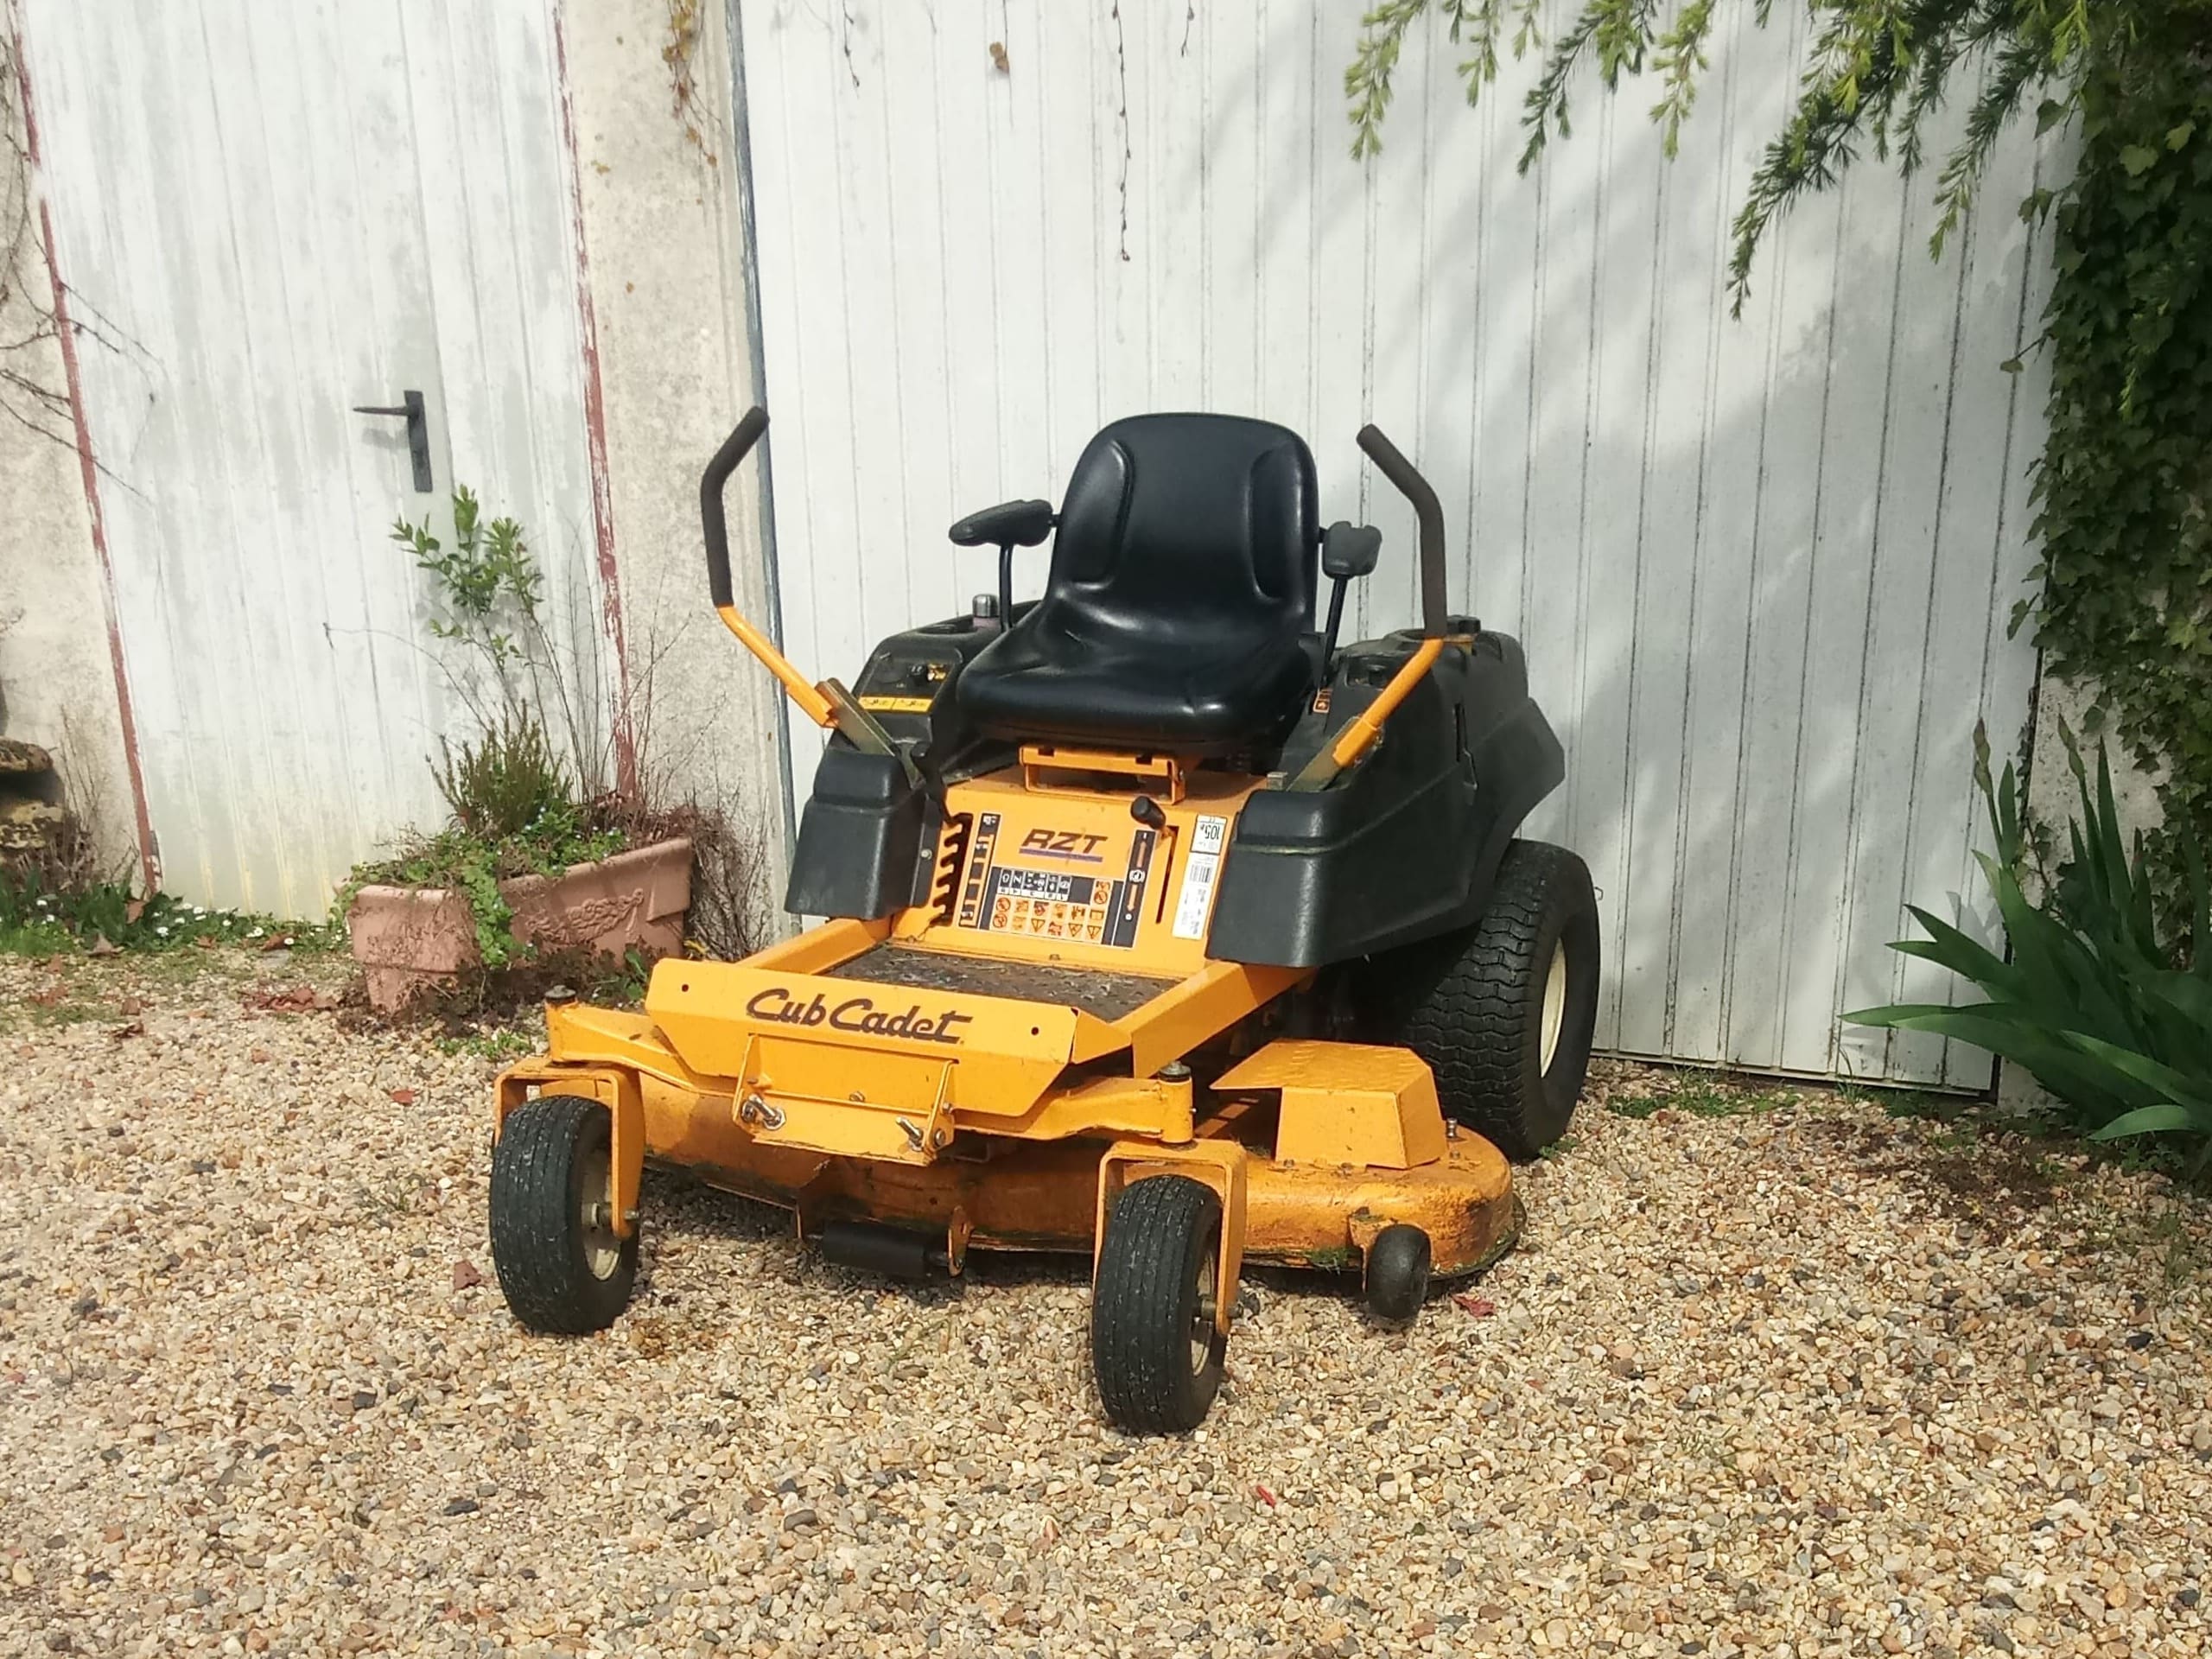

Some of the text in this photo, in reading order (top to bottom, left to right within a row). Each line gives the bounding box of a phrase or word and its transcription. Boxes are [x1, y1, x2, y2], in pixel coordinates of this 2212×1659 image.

[1021, 829, 1108, 854] RZT
[746, 988, 973, 1045] Cub Cadet
